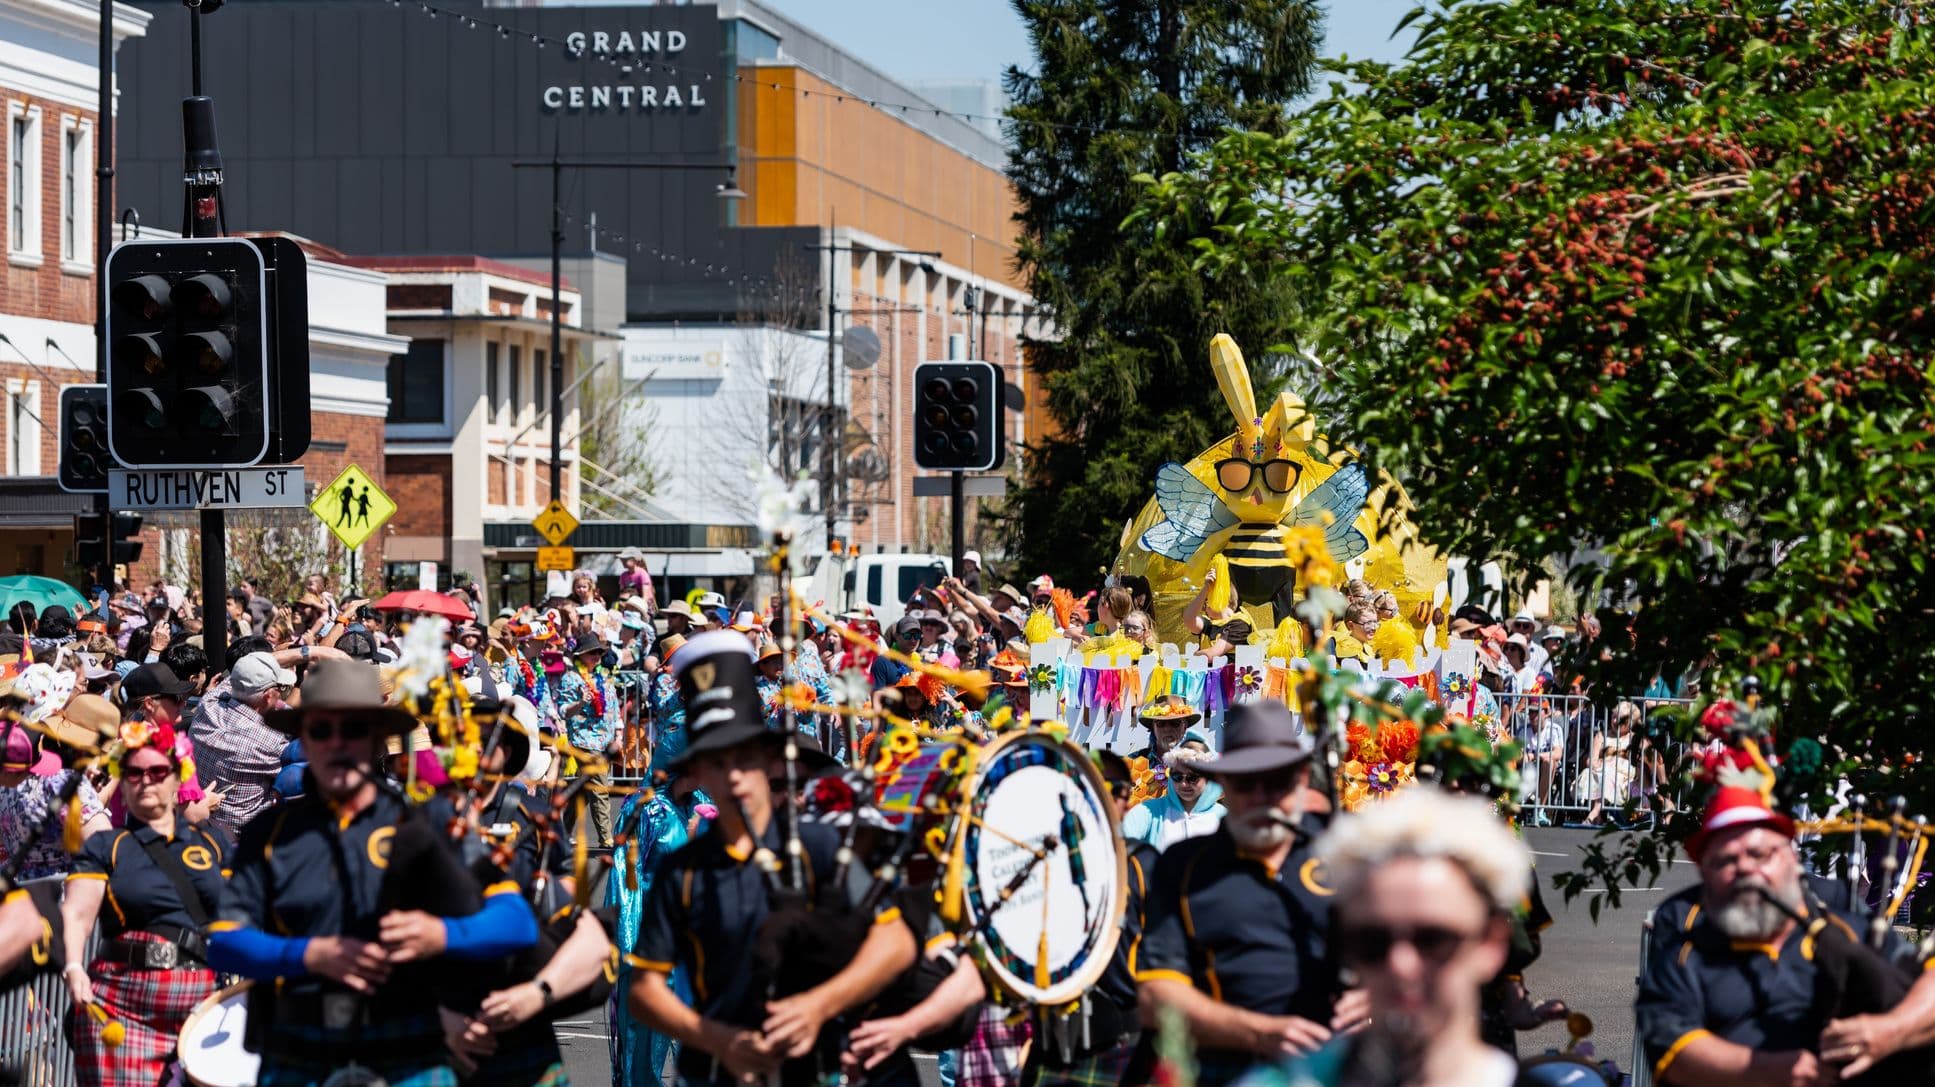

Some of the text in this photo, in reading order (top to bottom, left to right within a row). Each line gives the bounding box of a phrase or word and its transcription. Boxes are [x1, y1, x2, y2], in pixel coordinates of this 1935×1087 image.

[566, 31, 687, 53] GRAND
[543, 85, 706, 108] CENTRAL
[126, 470, 288, 505] RUTHVEN ST
